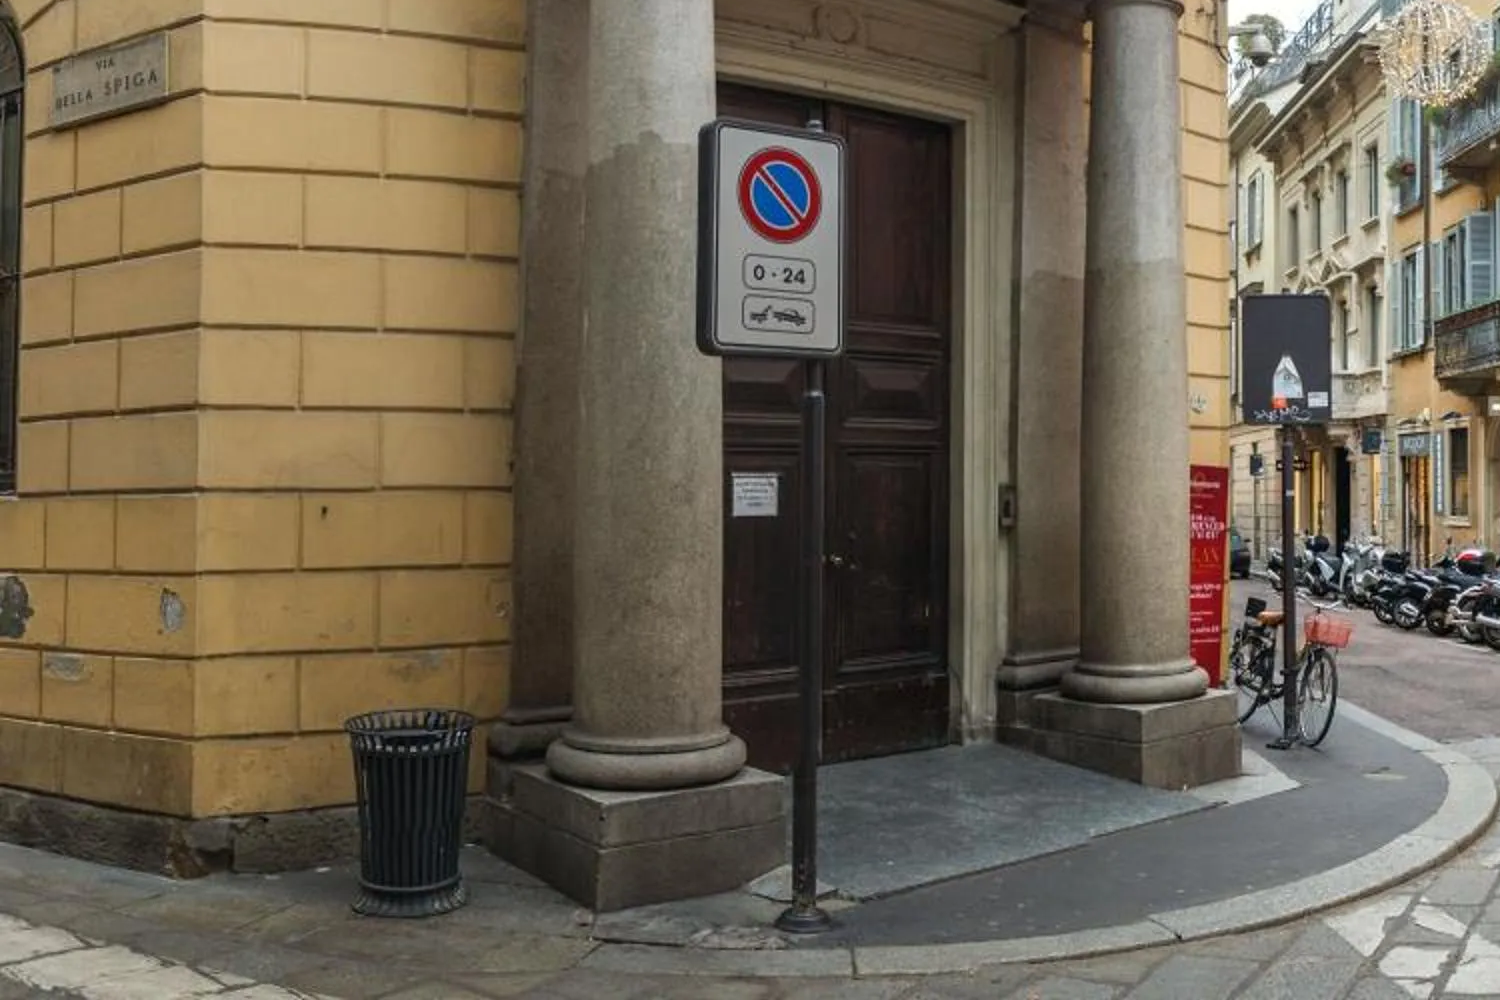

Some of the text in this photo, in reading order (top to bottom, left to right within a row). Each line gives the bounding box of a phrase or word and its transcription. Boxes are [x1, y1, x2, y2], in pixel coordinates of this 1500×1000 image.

[95, 56, 115, 70] VIA
[55, 70, 158, 110] DELLA SPIGA
[753, 264, 765, 281] 0
[783, 267, 805, 284] 24
